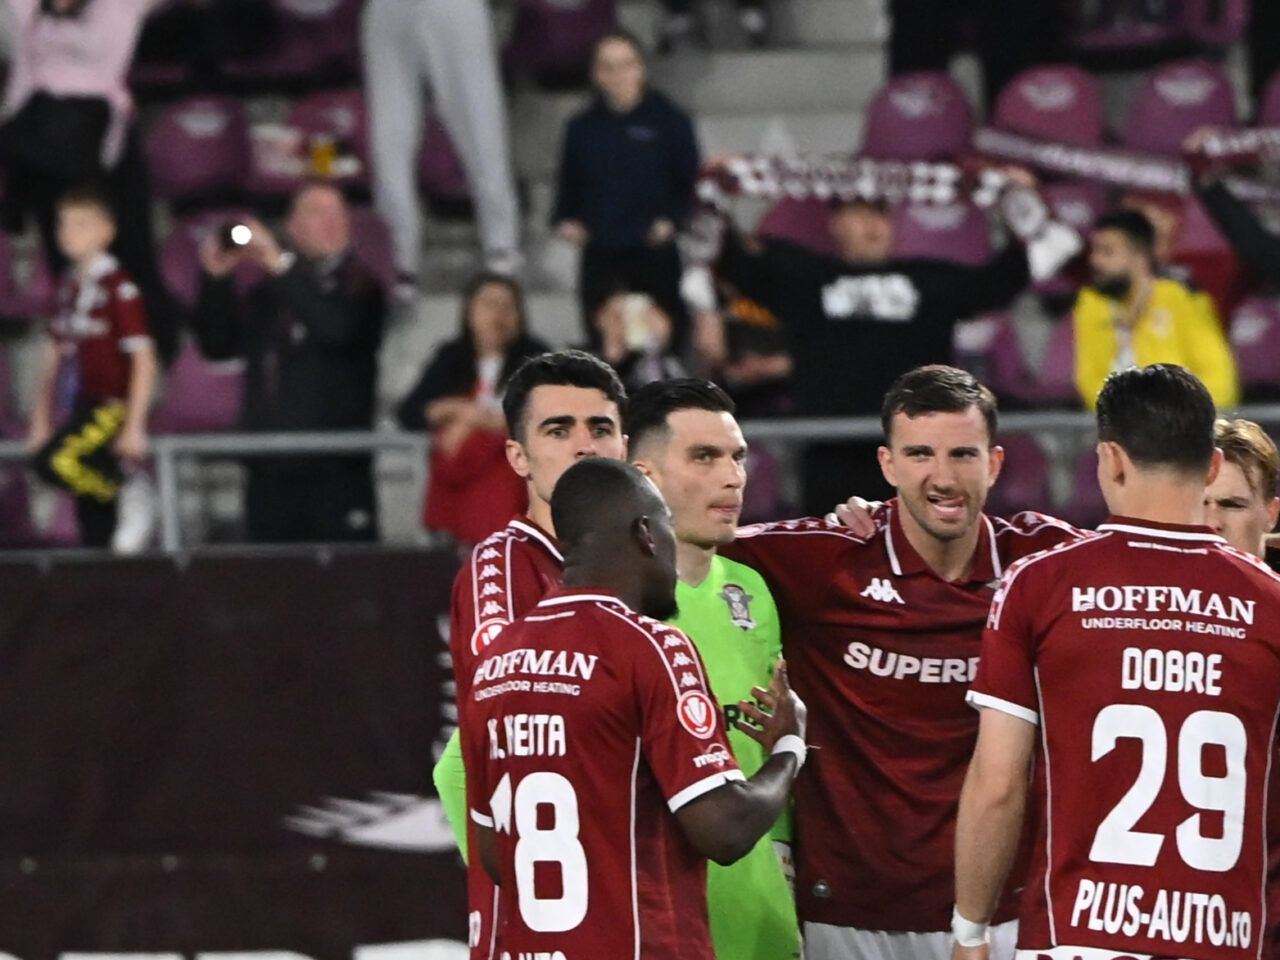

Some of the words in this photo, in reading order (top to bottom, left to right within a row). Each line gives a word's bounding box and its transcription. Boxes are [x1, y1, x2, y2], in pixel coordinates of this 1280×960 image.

[1072, 585, 1256, 625] HOFFMAN
[1081, 617, 1182, 634] UNDERFLOOR
[1185, 620, 1246, 640] HEATING
[473, 648, 599, 686] HOFFMAN
[1121, 647, 1223, 696] DOBRE
[1089, 703, 1248, 873] 29
[1070, 878, 1251, 949] PLUS-AUTO.ro
